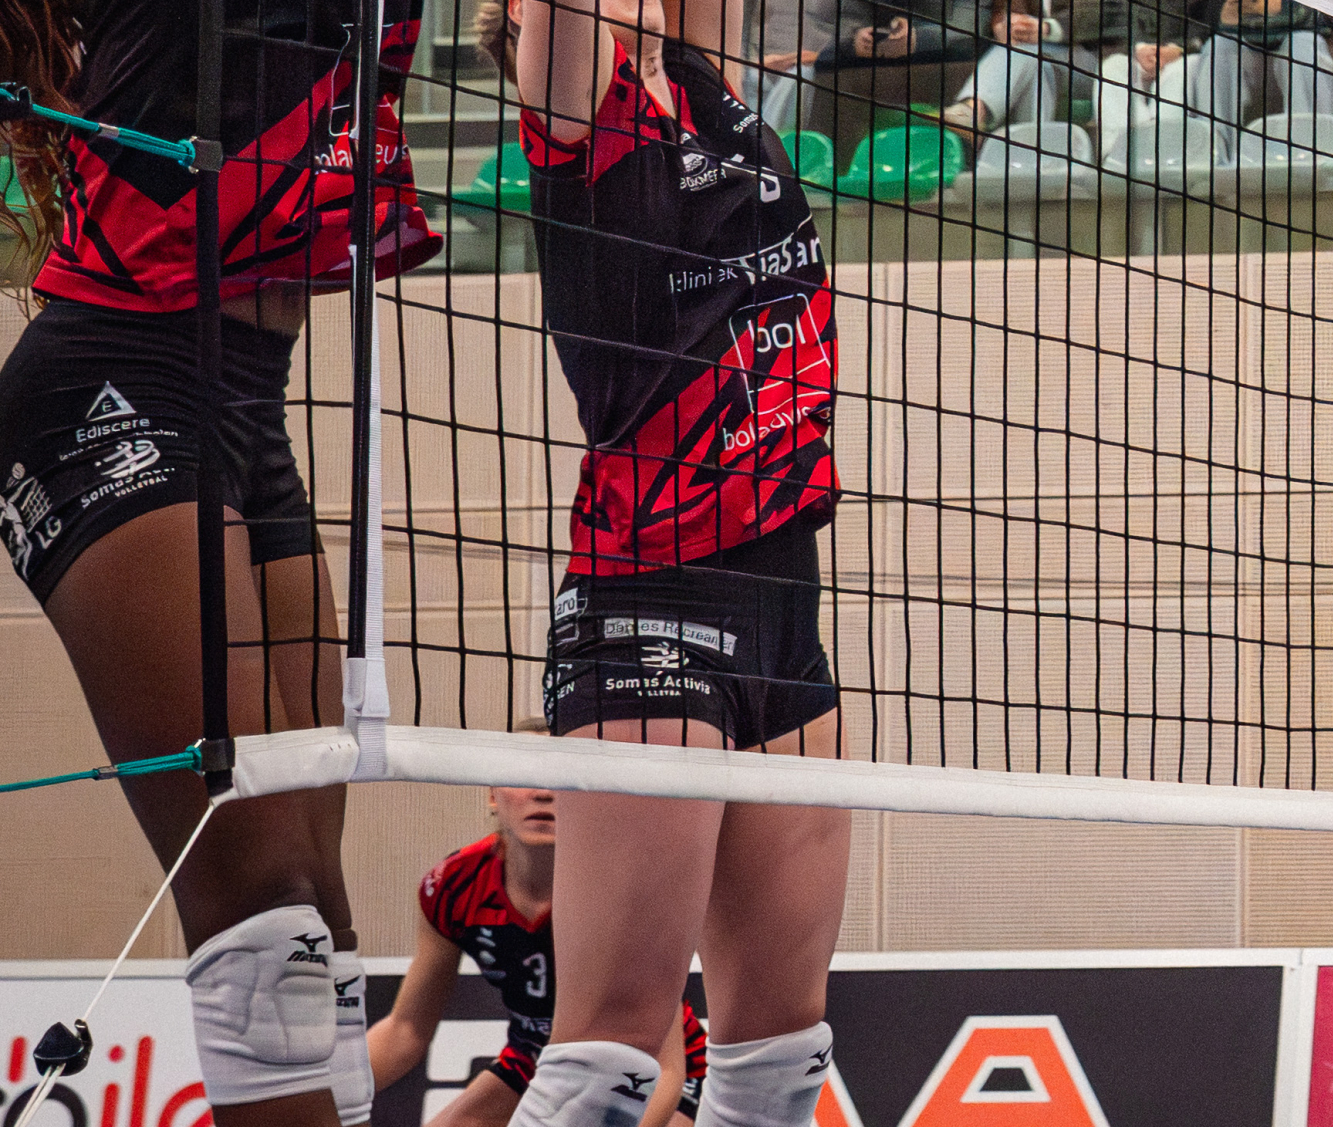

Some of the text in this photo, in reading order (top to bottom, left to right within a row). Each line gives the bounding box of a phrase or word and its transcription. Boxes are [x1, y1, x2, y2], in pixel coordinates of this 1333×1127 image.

[746, 314, 807, 353] bol
[75, 418, 151, 443] Ediscere
[522, 952, 548, 998] 3
